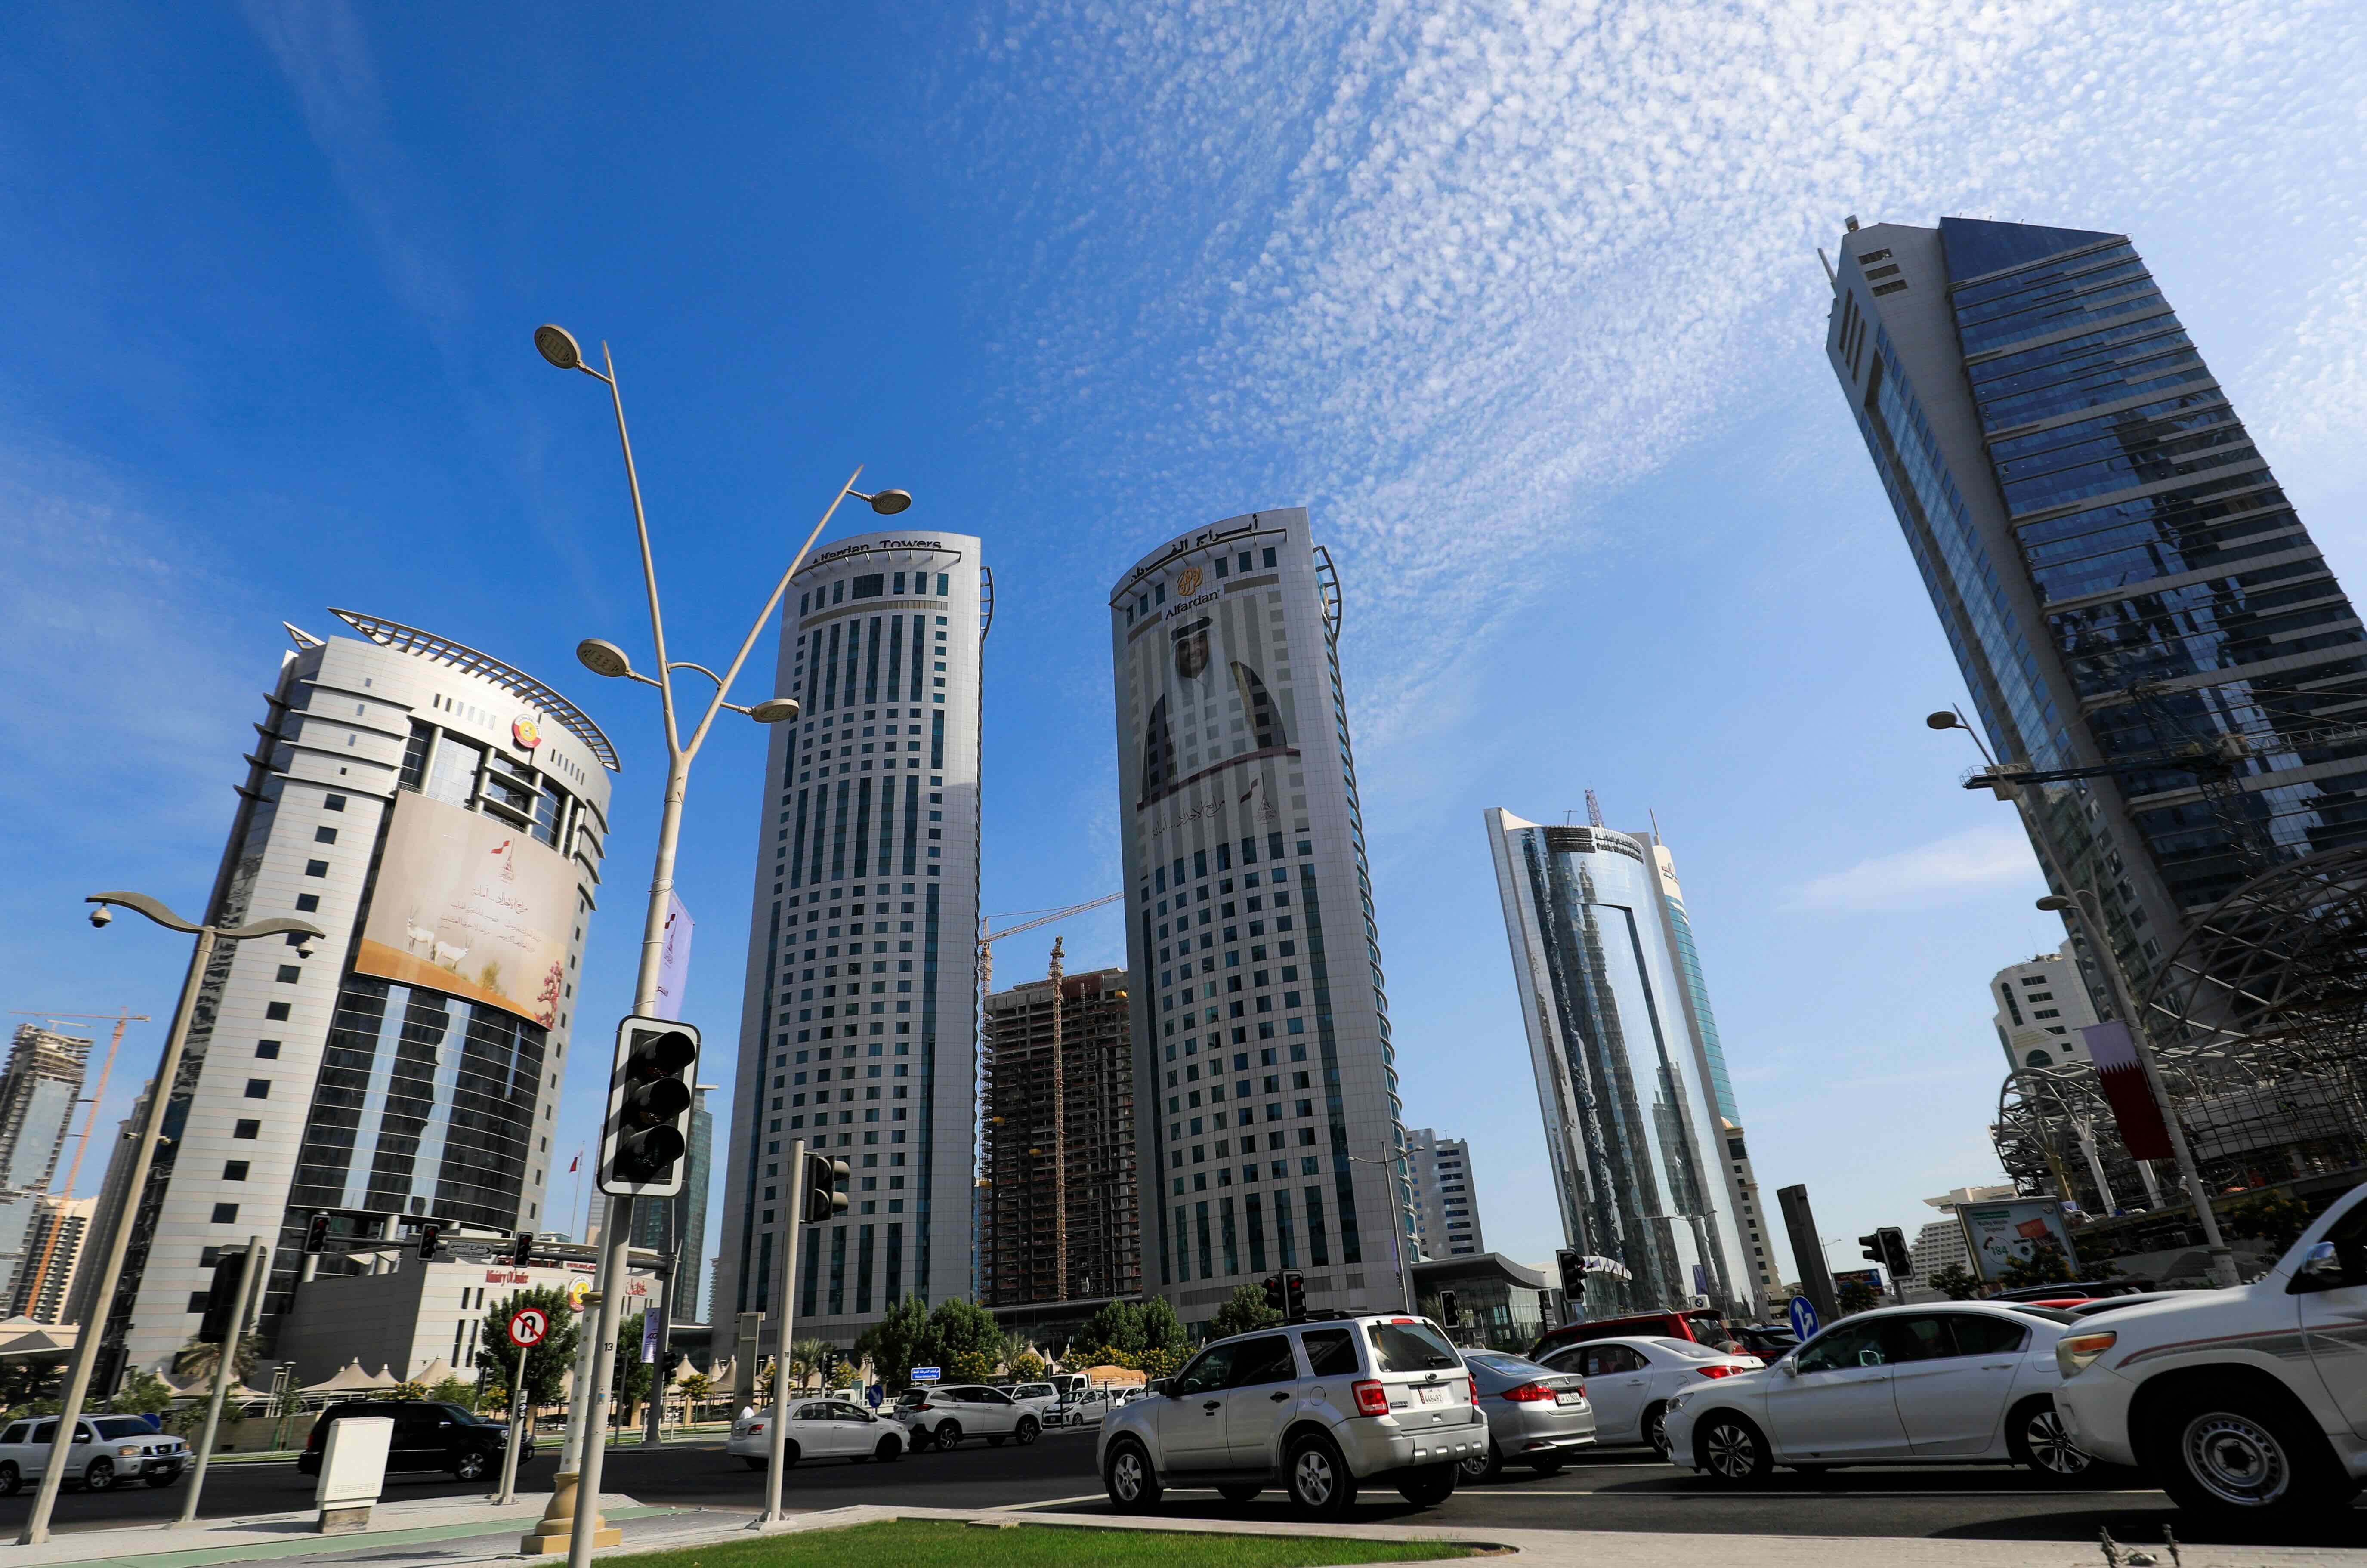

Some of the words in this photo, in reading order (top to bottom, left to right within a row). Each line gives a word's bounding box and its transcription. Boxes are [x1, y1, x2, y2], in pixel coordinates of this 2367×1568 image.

[880, 540, 942, 549] Towers
[1165, 590, 1219, 620] Alfardan
[1990, 1246, 2009, 1256] 184
[486, 1270, 507, 1287] Ministry
[513, 1271, 529, 1284] Justice
[604, 1343, 613, 1352] 13
